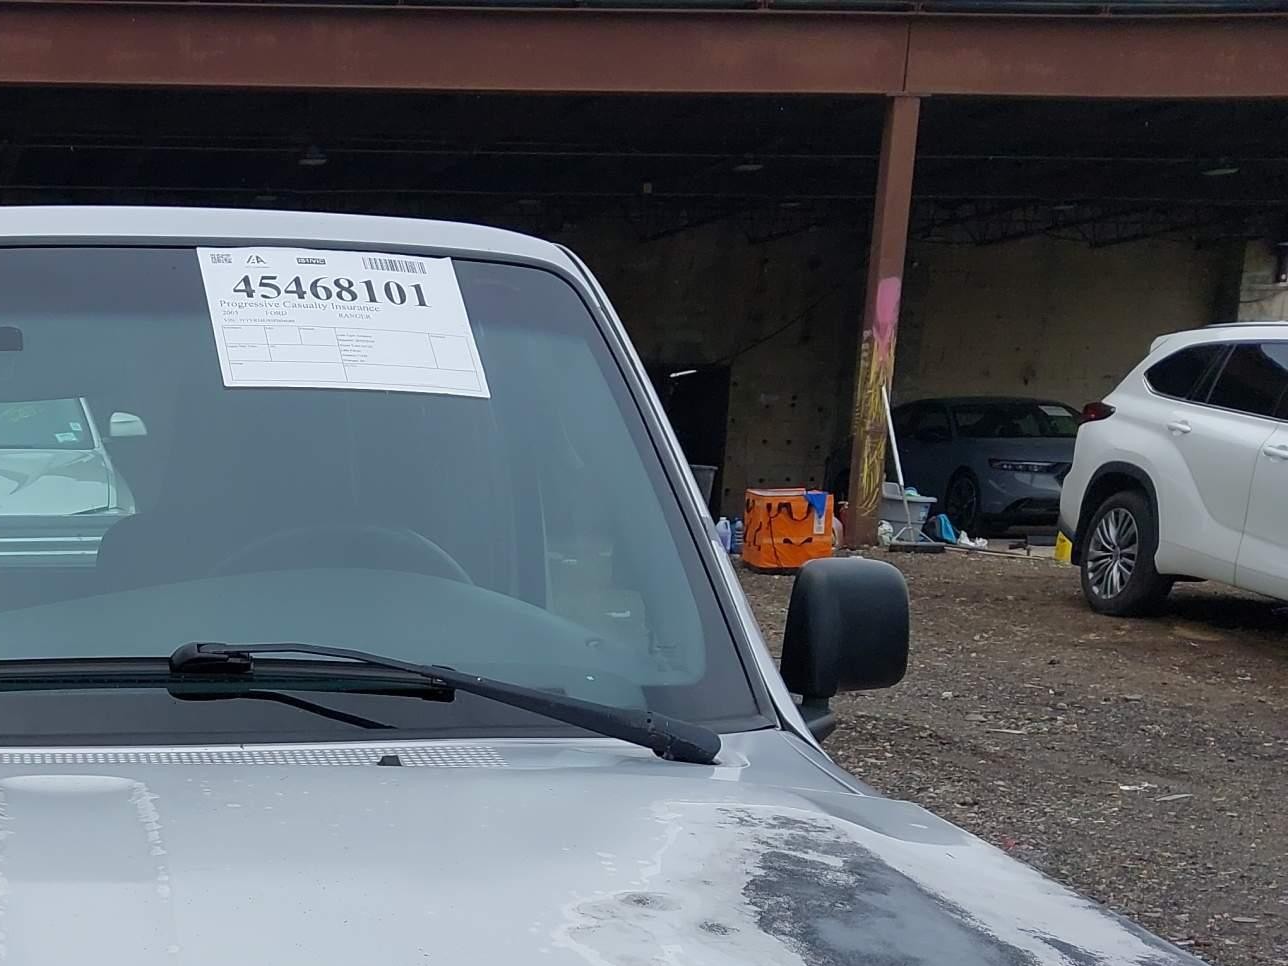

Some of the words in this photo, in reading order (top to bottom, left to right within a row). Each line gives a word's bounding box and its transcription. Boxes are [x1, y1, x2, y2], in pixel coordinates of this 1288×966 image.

[233, 274, 431, 308] 45468101
[219, 300, 280, 309] Progressive
[283, 301, 327, 311] Casualty
[331, 302, 380, 312] Insurance
